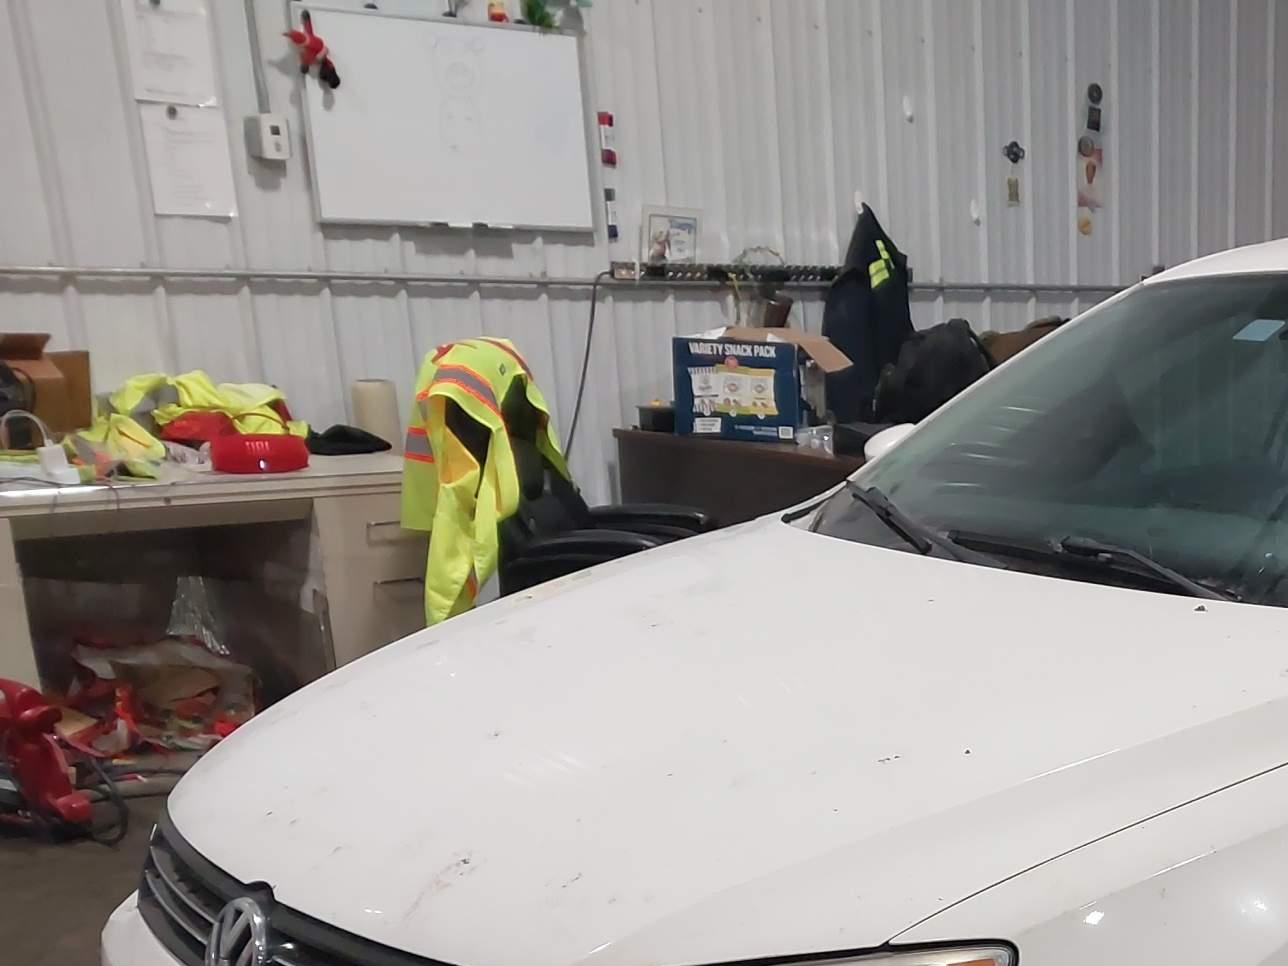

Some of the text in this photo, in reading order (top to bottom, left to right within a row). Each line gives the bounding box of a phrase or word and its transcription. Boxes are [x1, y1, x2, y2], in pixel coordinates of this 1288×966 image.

[688, 342, 776, 358] VARIETY SNACK PACK
